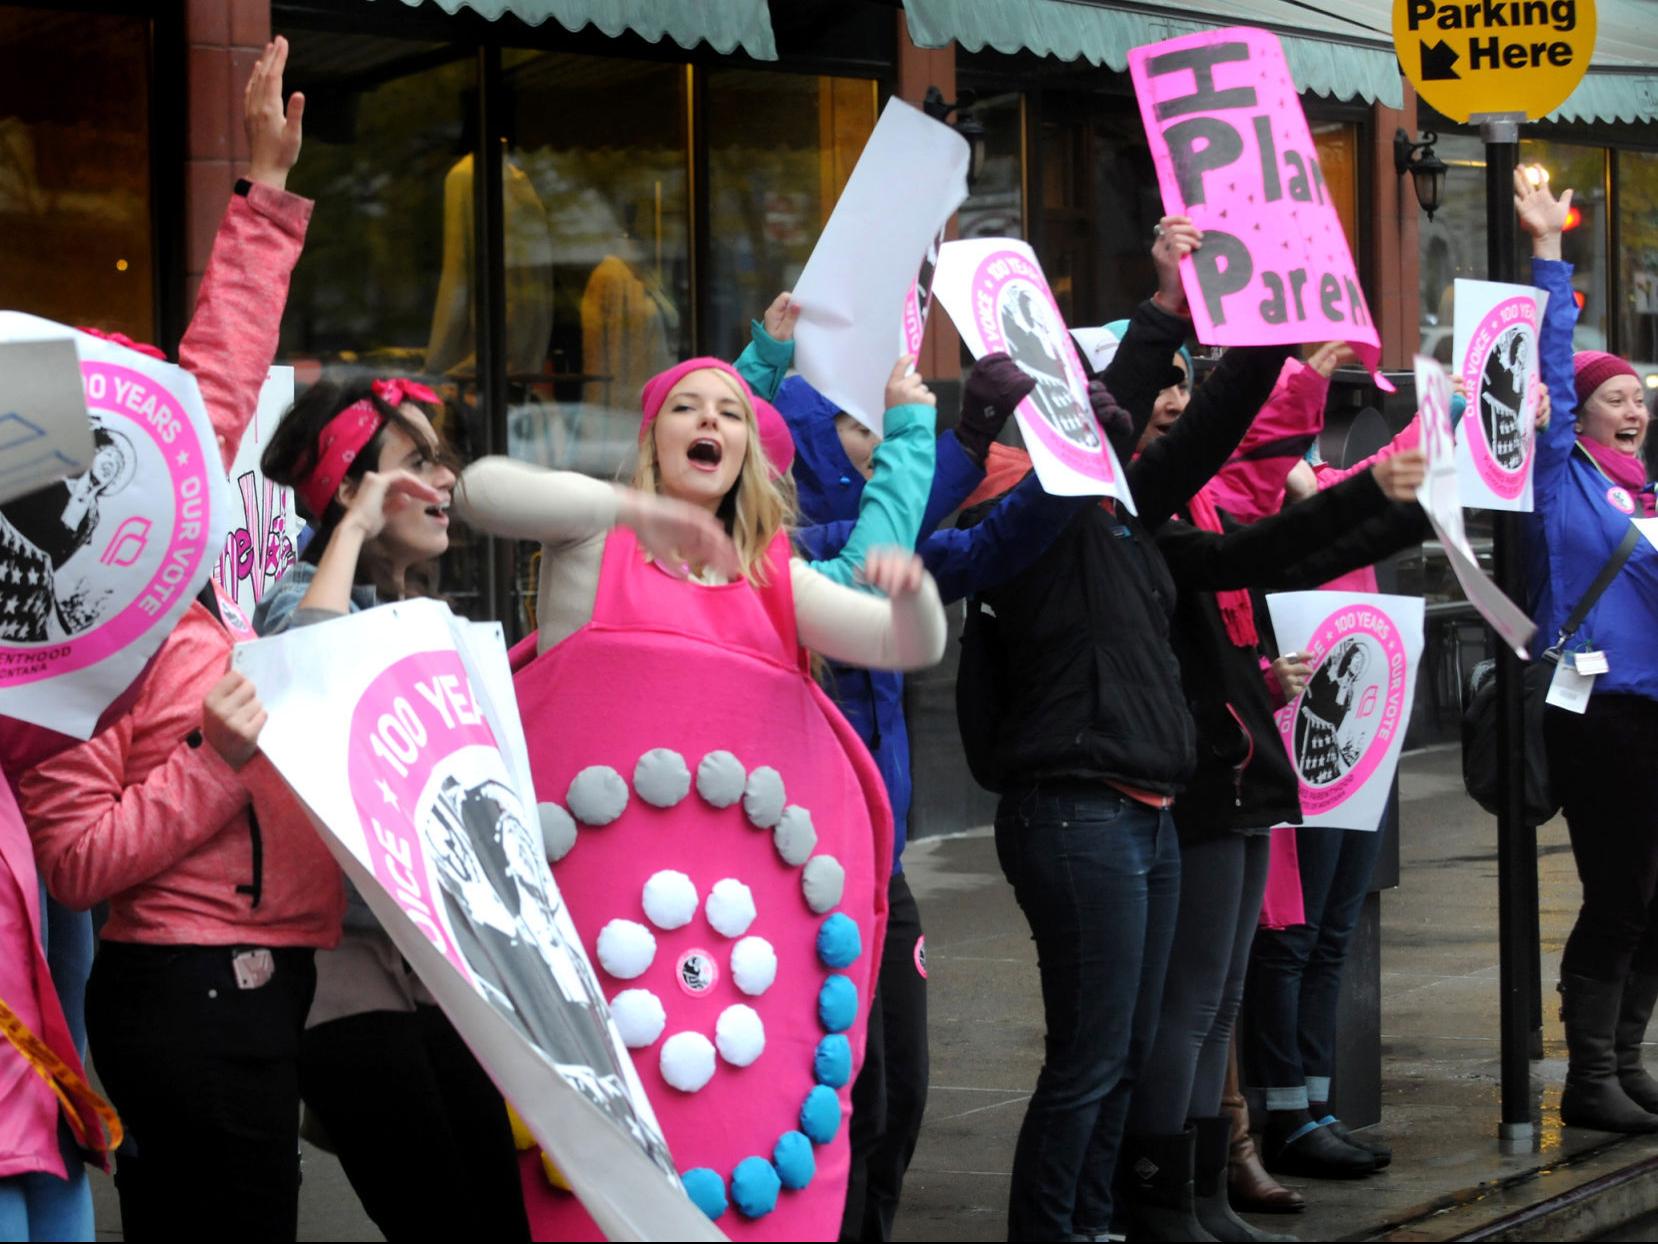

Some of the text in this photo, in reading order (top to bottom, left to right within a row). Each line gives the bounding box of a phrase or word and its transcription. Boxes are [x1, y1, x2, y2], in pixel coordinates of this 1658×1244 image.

[1408, 0, 1576, 32] Parking
[1469, 36, 1574, 70] Here
[1144, 42, 1258, 123] I
[1501, 304, 1518, 323] 100
[113, 376, 182, 444] YEARS
[1466, 329, 1491, 417] OUR VOICE
[137, 476, 202, 616] OUR VOTE
[1335, 610, 1391, 640] 100 YEARS
[1378, 653, 1403, 741] OUR VOTE
[369, 696, 428, 778] 100
